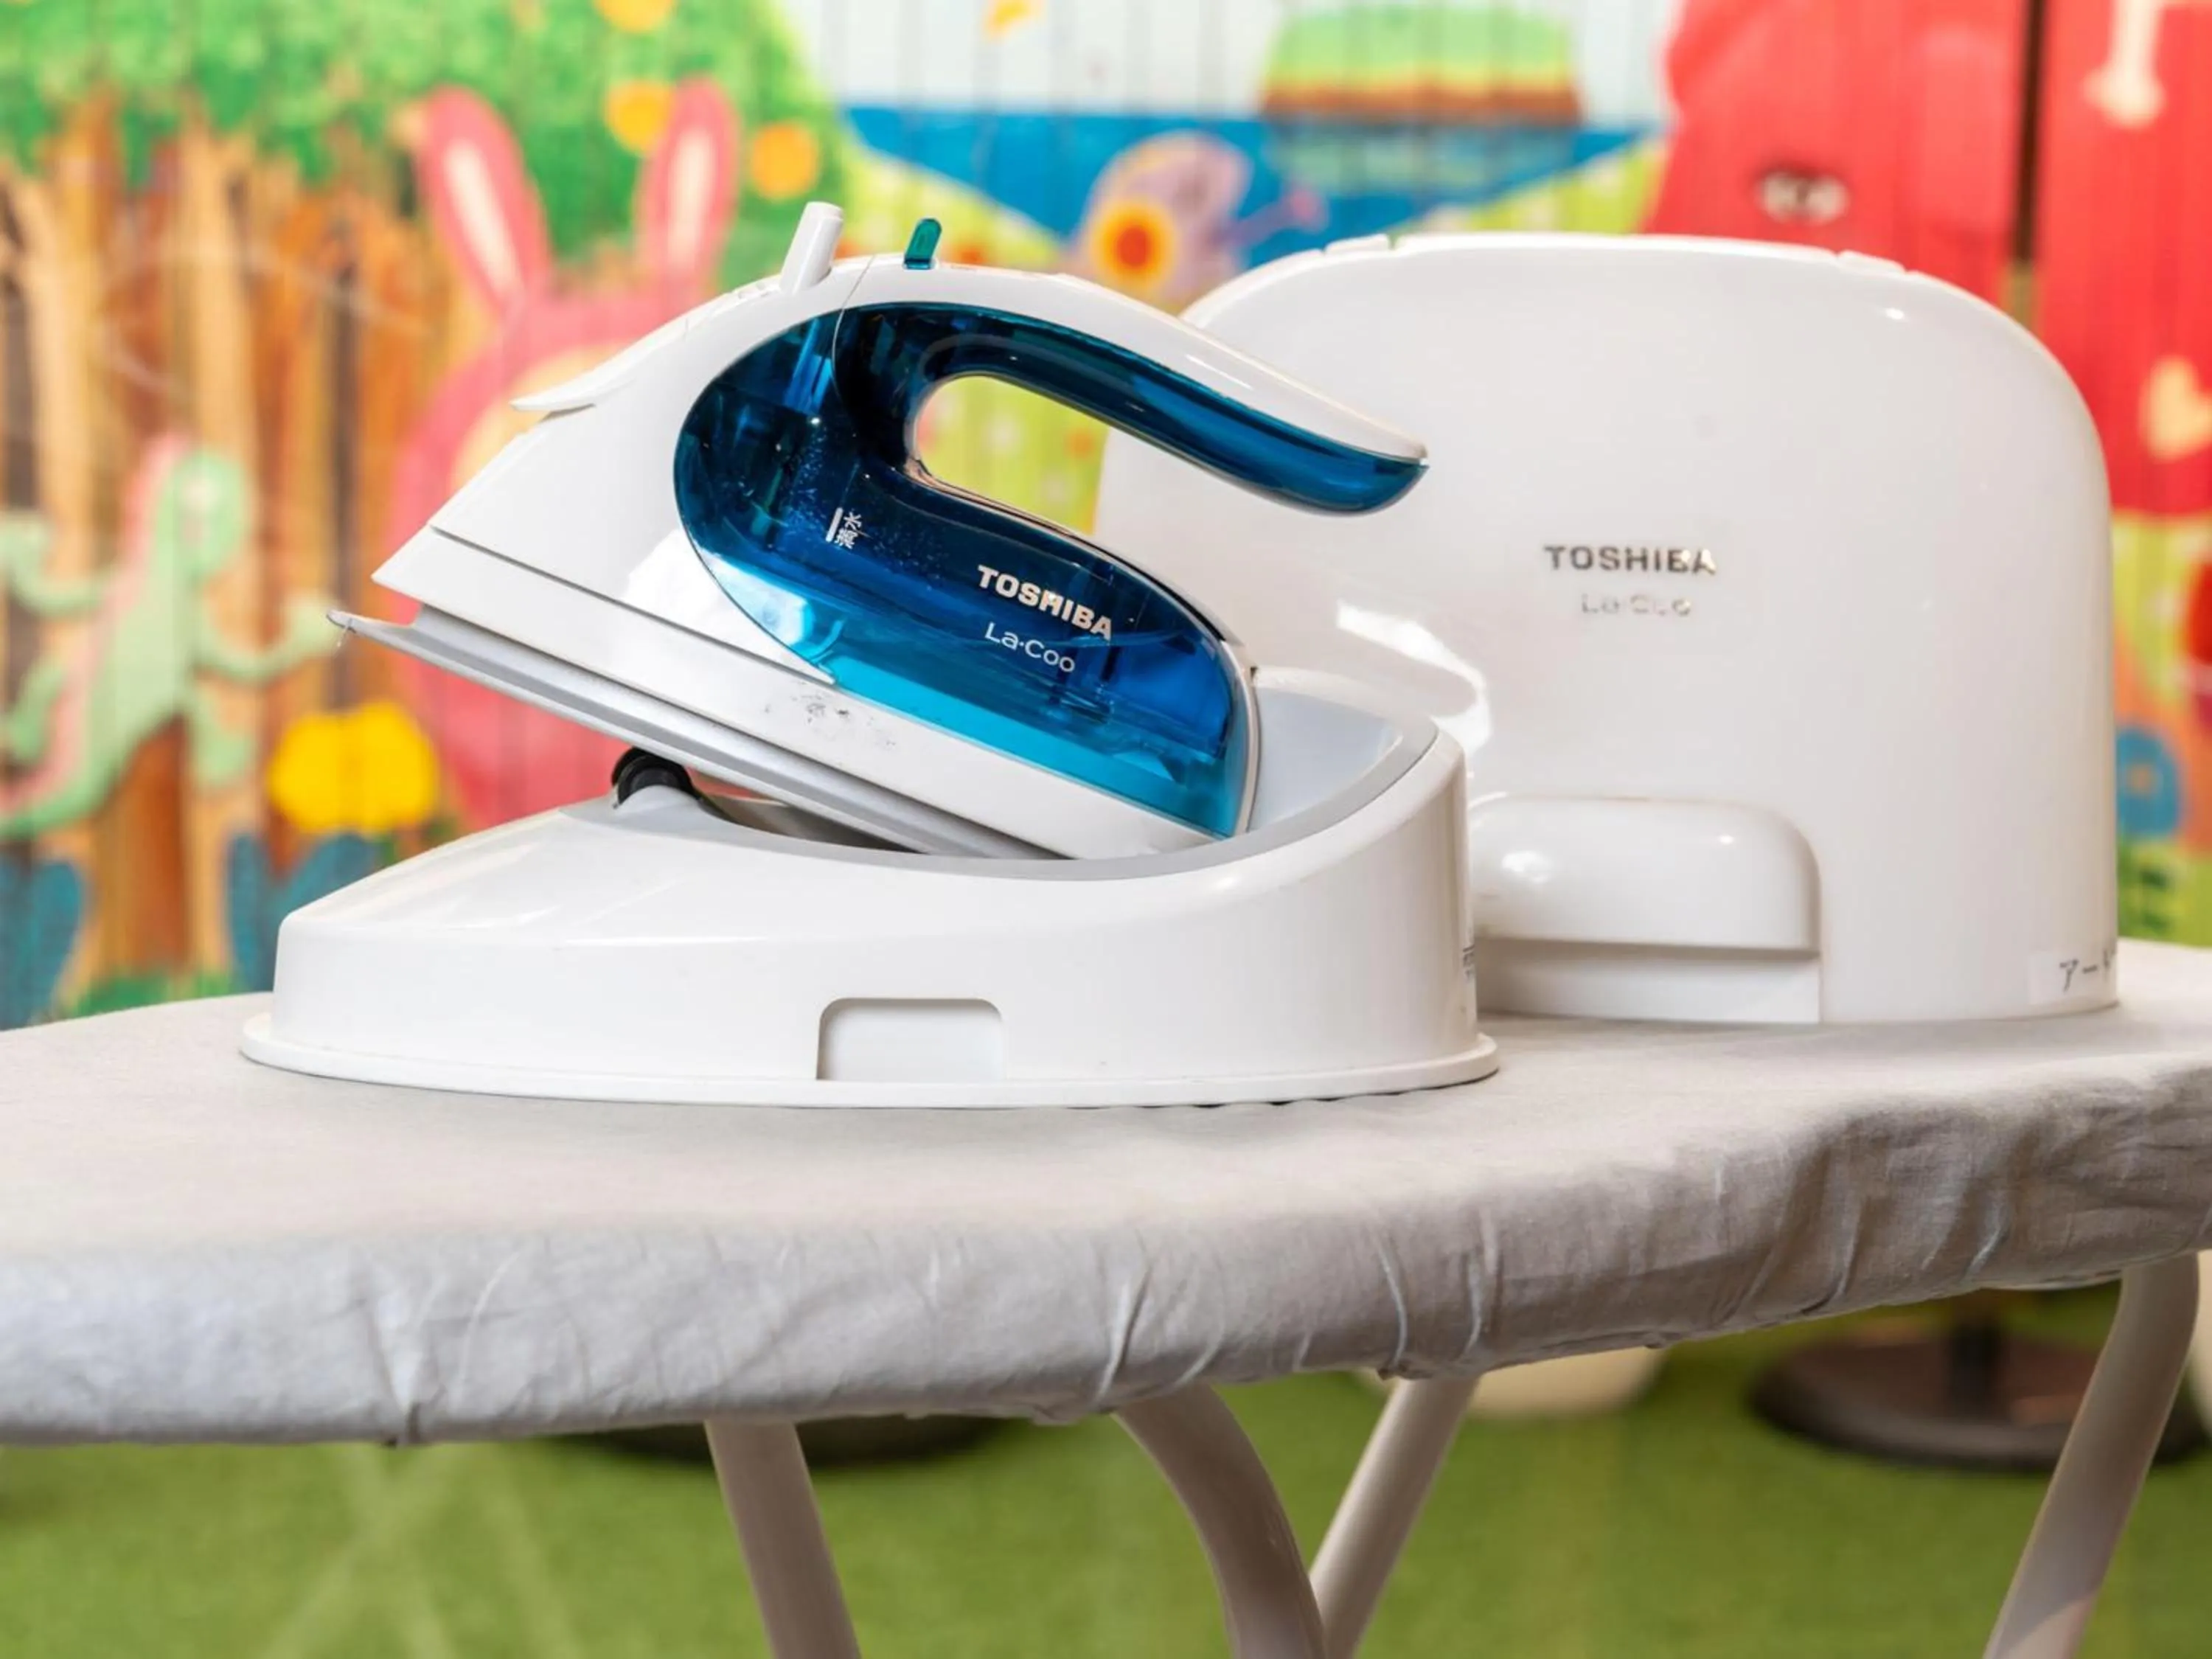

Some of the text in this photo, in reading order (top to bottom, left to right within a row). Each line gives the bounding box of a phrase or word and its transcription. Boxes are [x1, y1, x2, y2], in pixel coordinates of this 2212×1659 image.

[834, 512, 862, 549] 満水
[1543, 545, 1717, 575] TOSHIBA
[978, 565, 1112, 639] TOSHIBA
